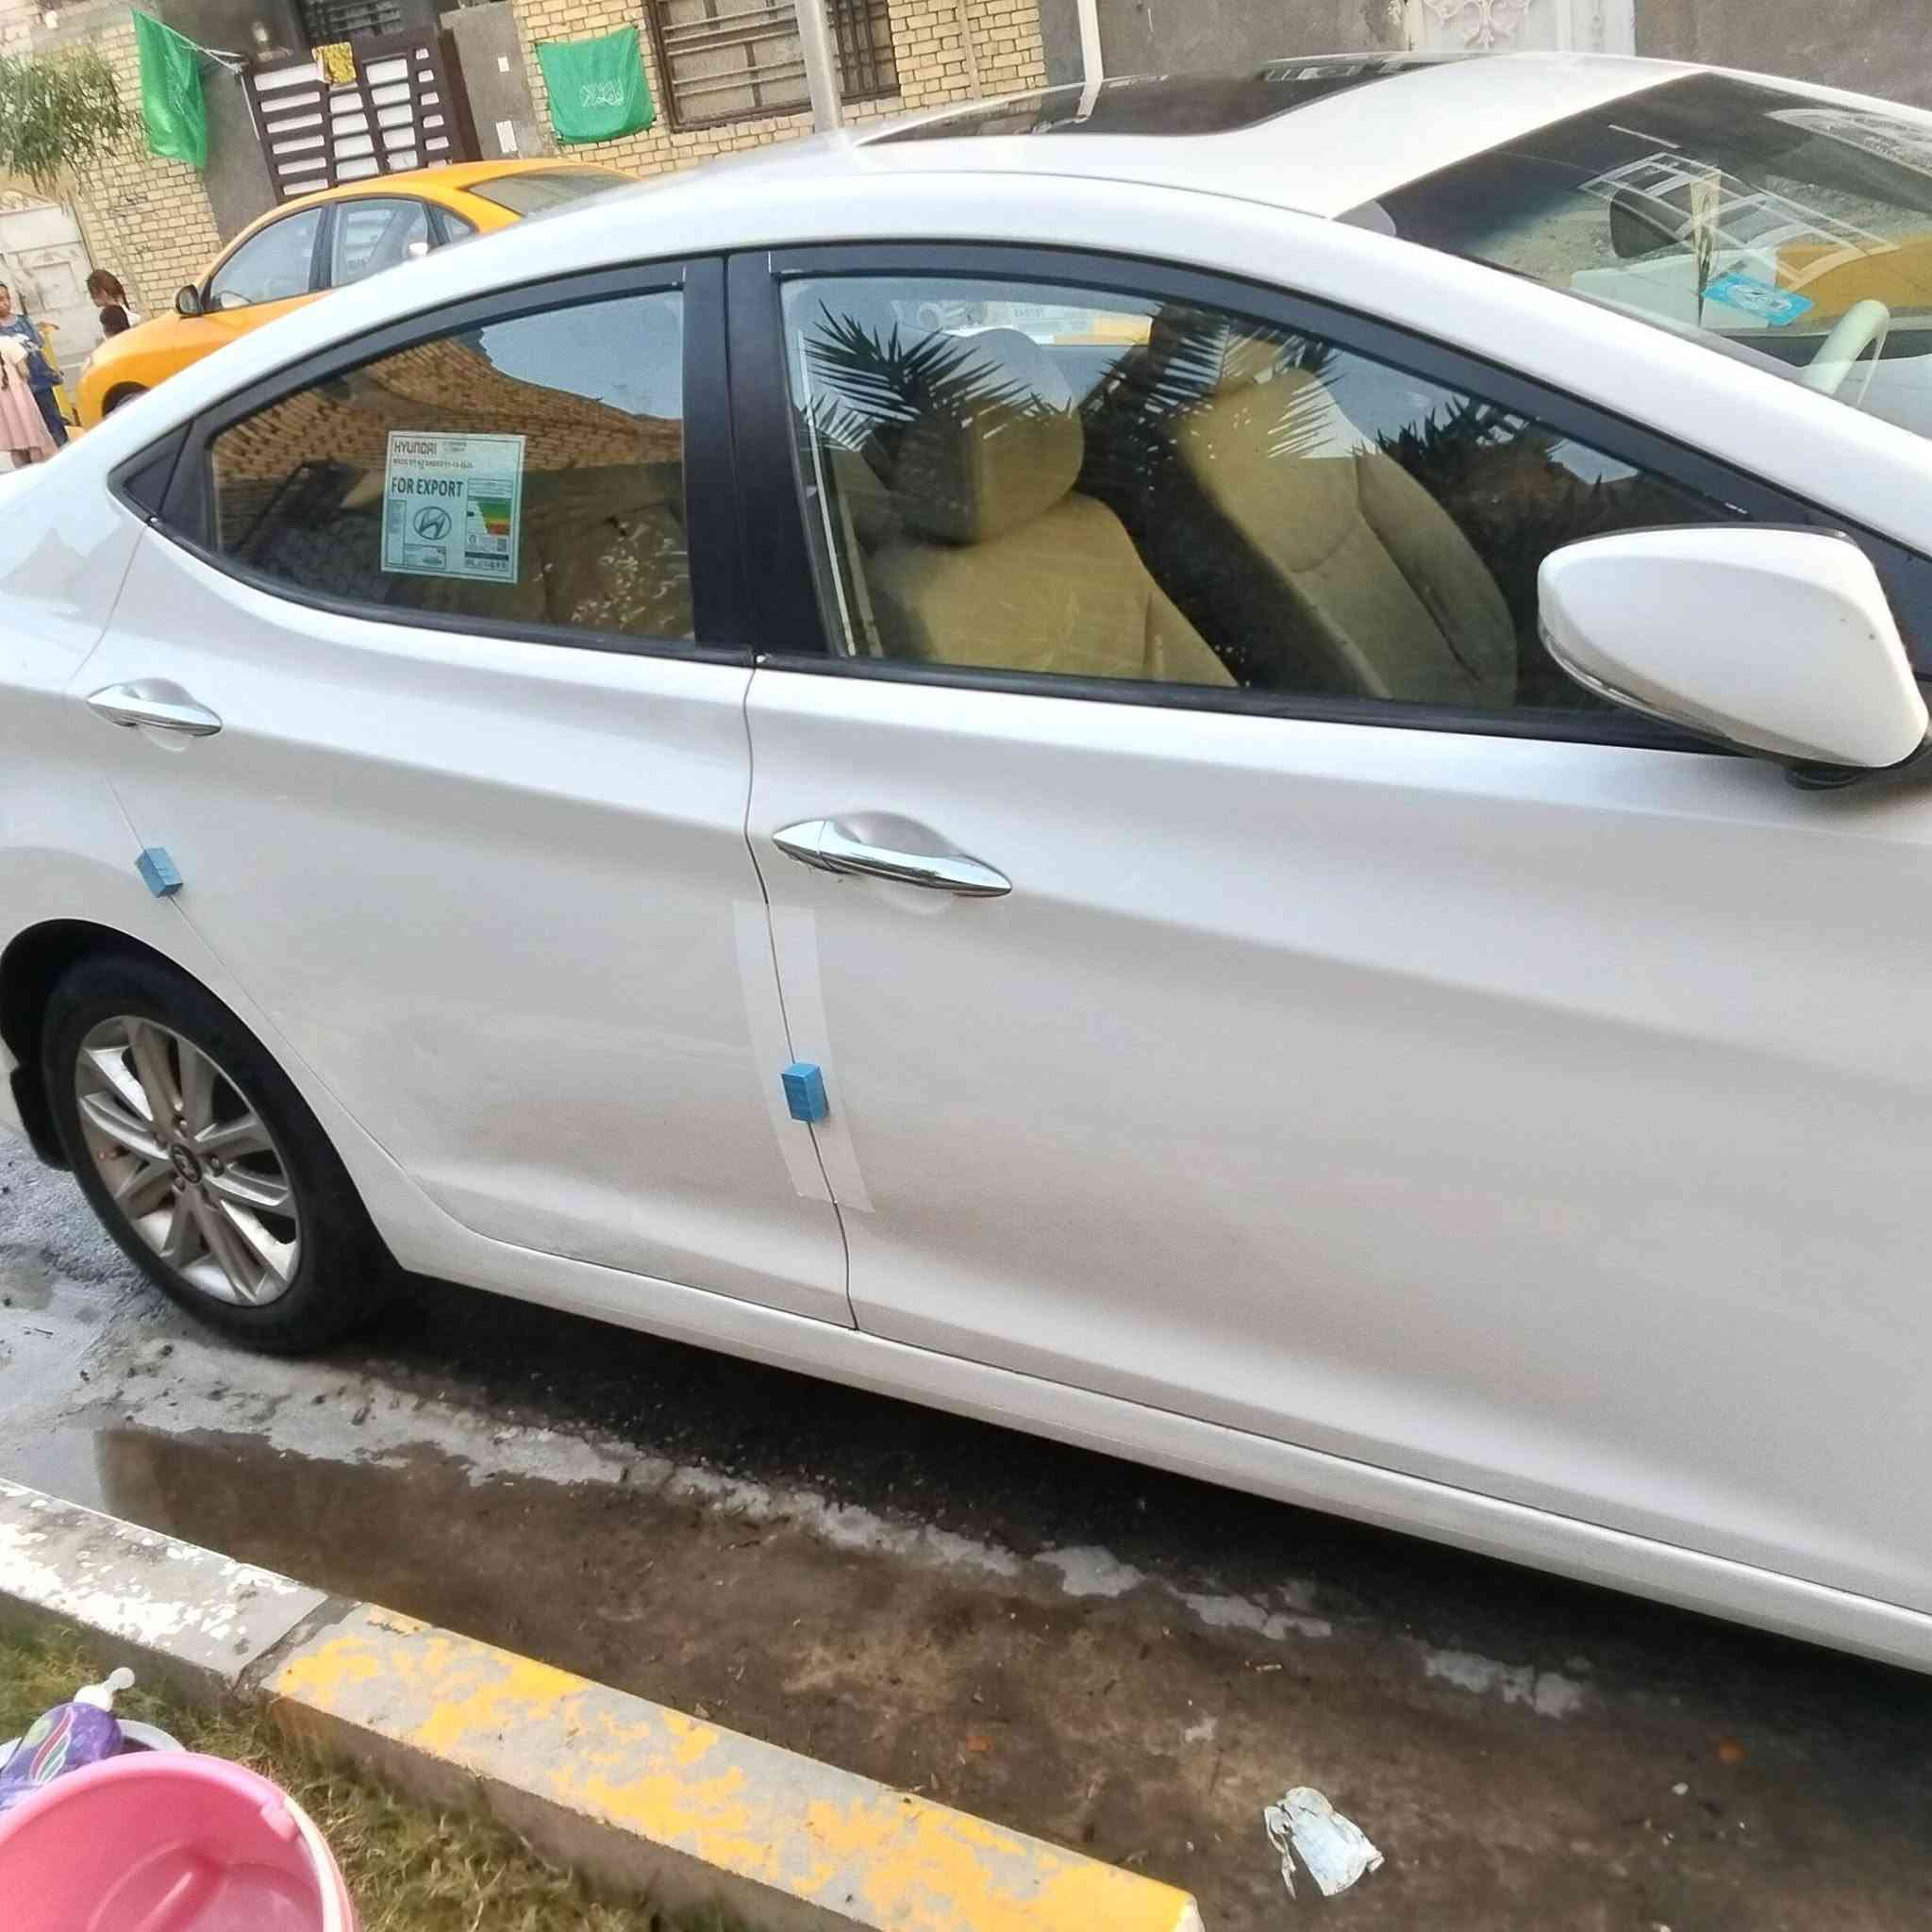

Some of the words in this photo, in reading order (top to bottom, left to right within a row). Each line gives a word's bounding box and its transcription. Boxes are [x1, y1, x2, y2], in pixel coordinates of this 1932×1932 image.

[393, 441, 438, 455] HYUNDAI
[391, 477, 414, 494] FOR
[416, 478, 464, 498] EXPORT
